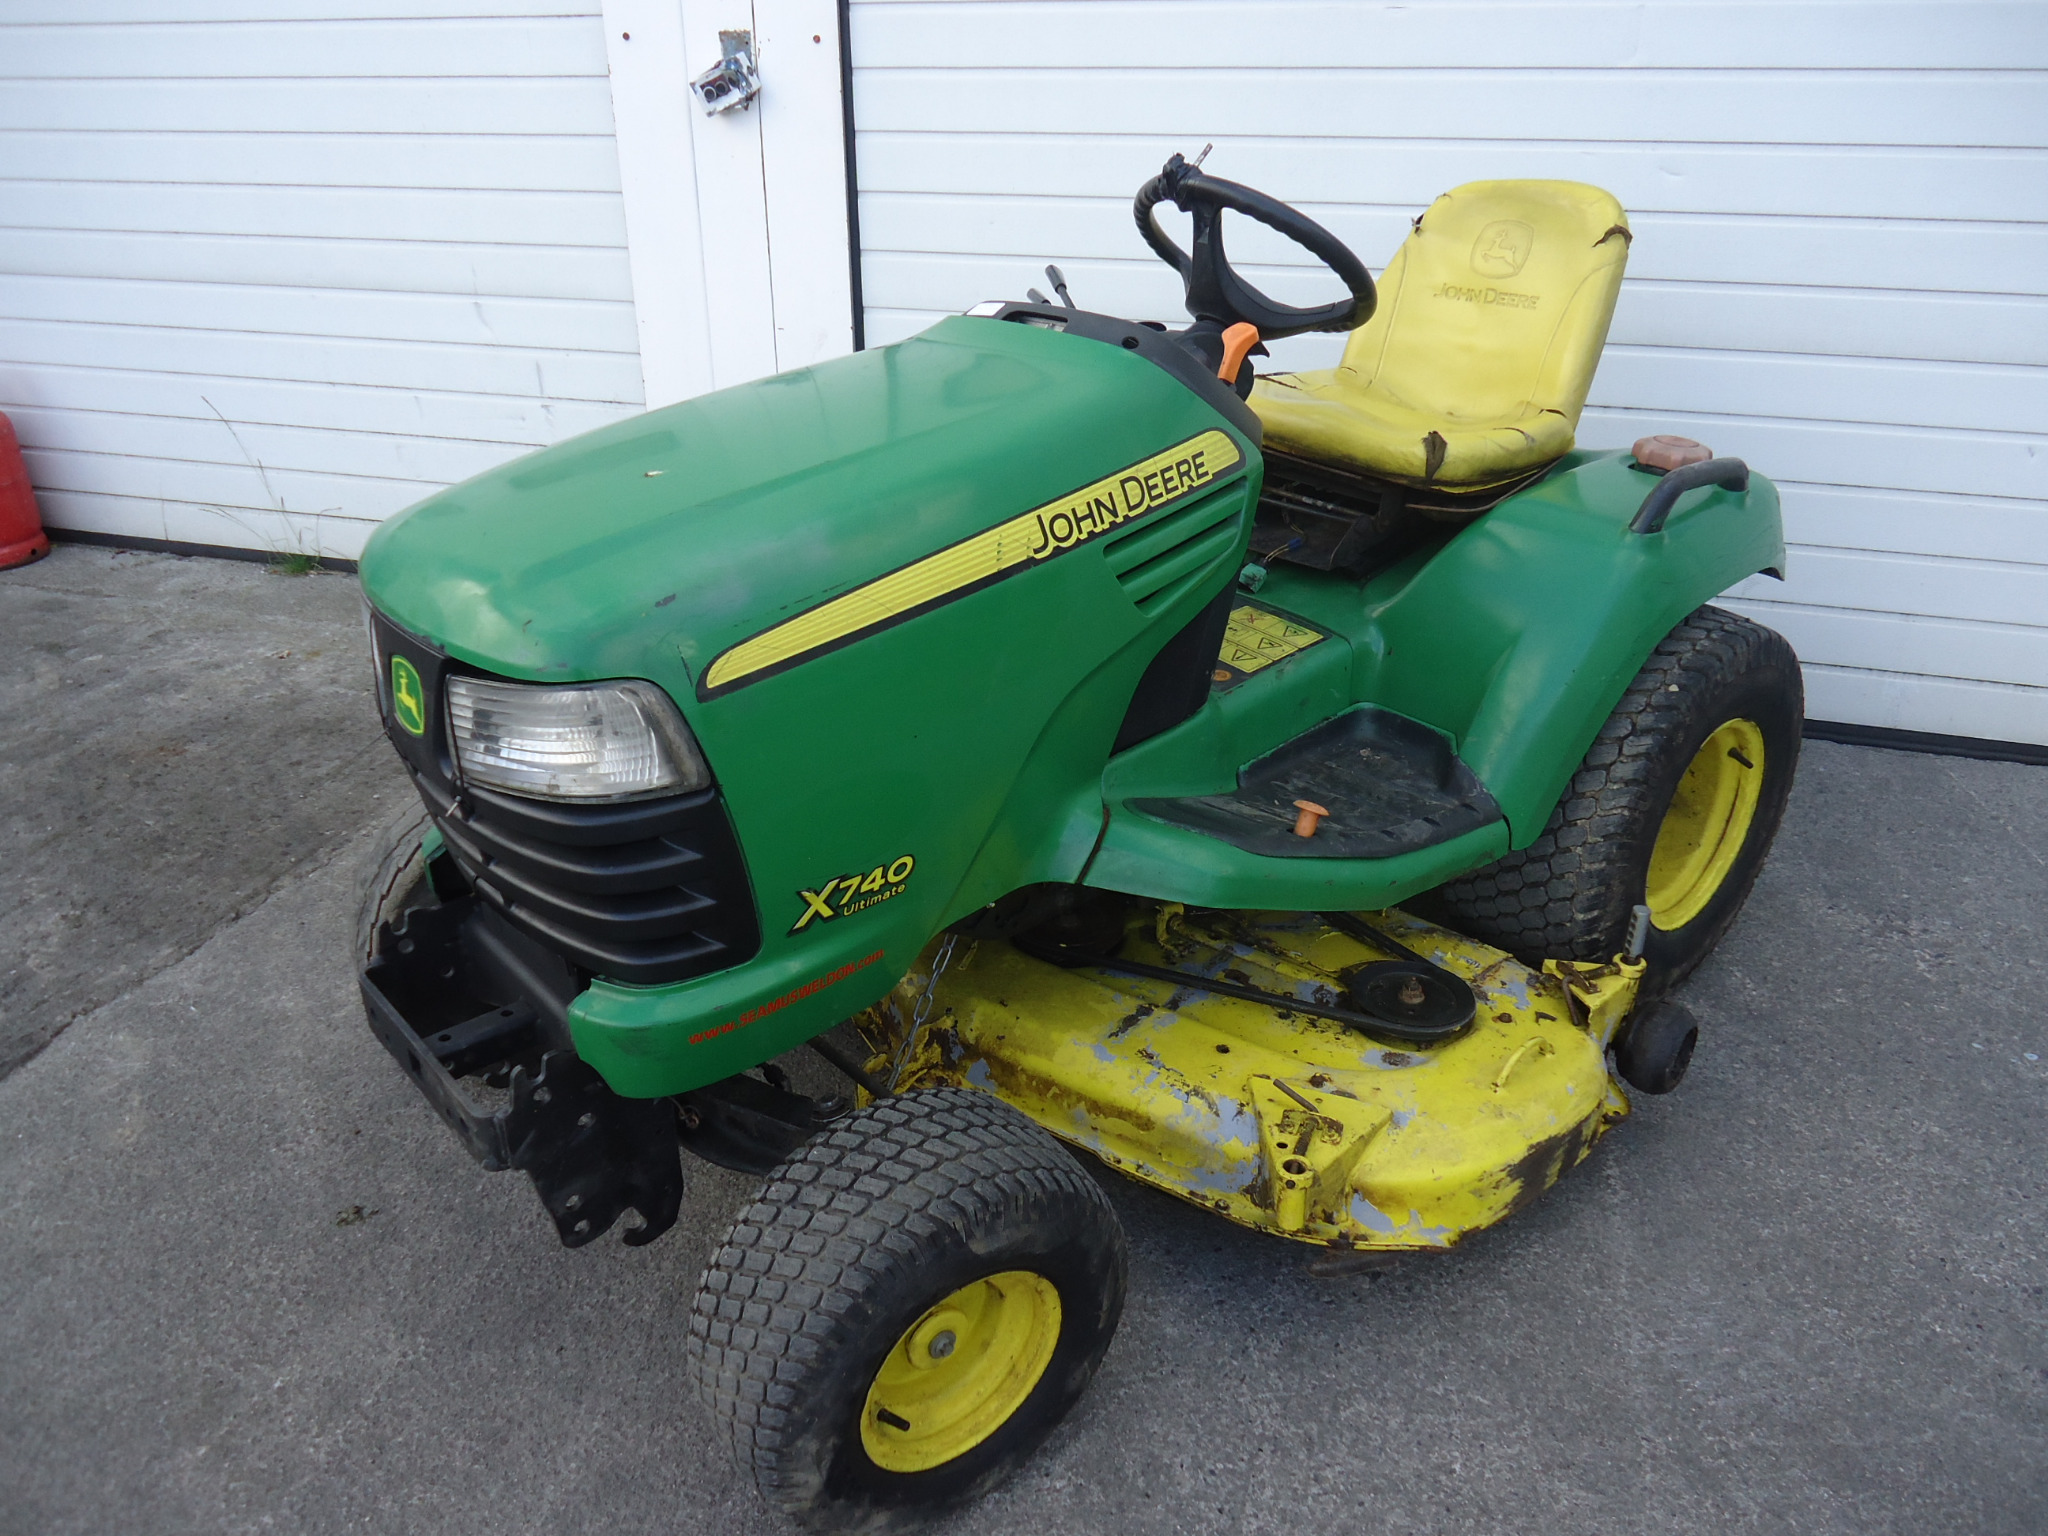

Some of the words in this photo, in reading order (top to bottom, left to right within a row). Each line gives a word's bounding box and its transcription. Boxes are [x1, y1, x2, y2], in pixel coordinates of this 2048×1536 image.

[1433, 282, 1483, 302] JOHN
[1483, 287, 1540, 310] DEERE
[1032, 491, 1120, 554] JOHN
[1118, 450, 1210, 513] DEERE
[790, 854, 915, 934] X740
[842, 882, 907, 917] Ultimate
[687, 948, 885, 1046] www.SEAMUSWELDON.com
